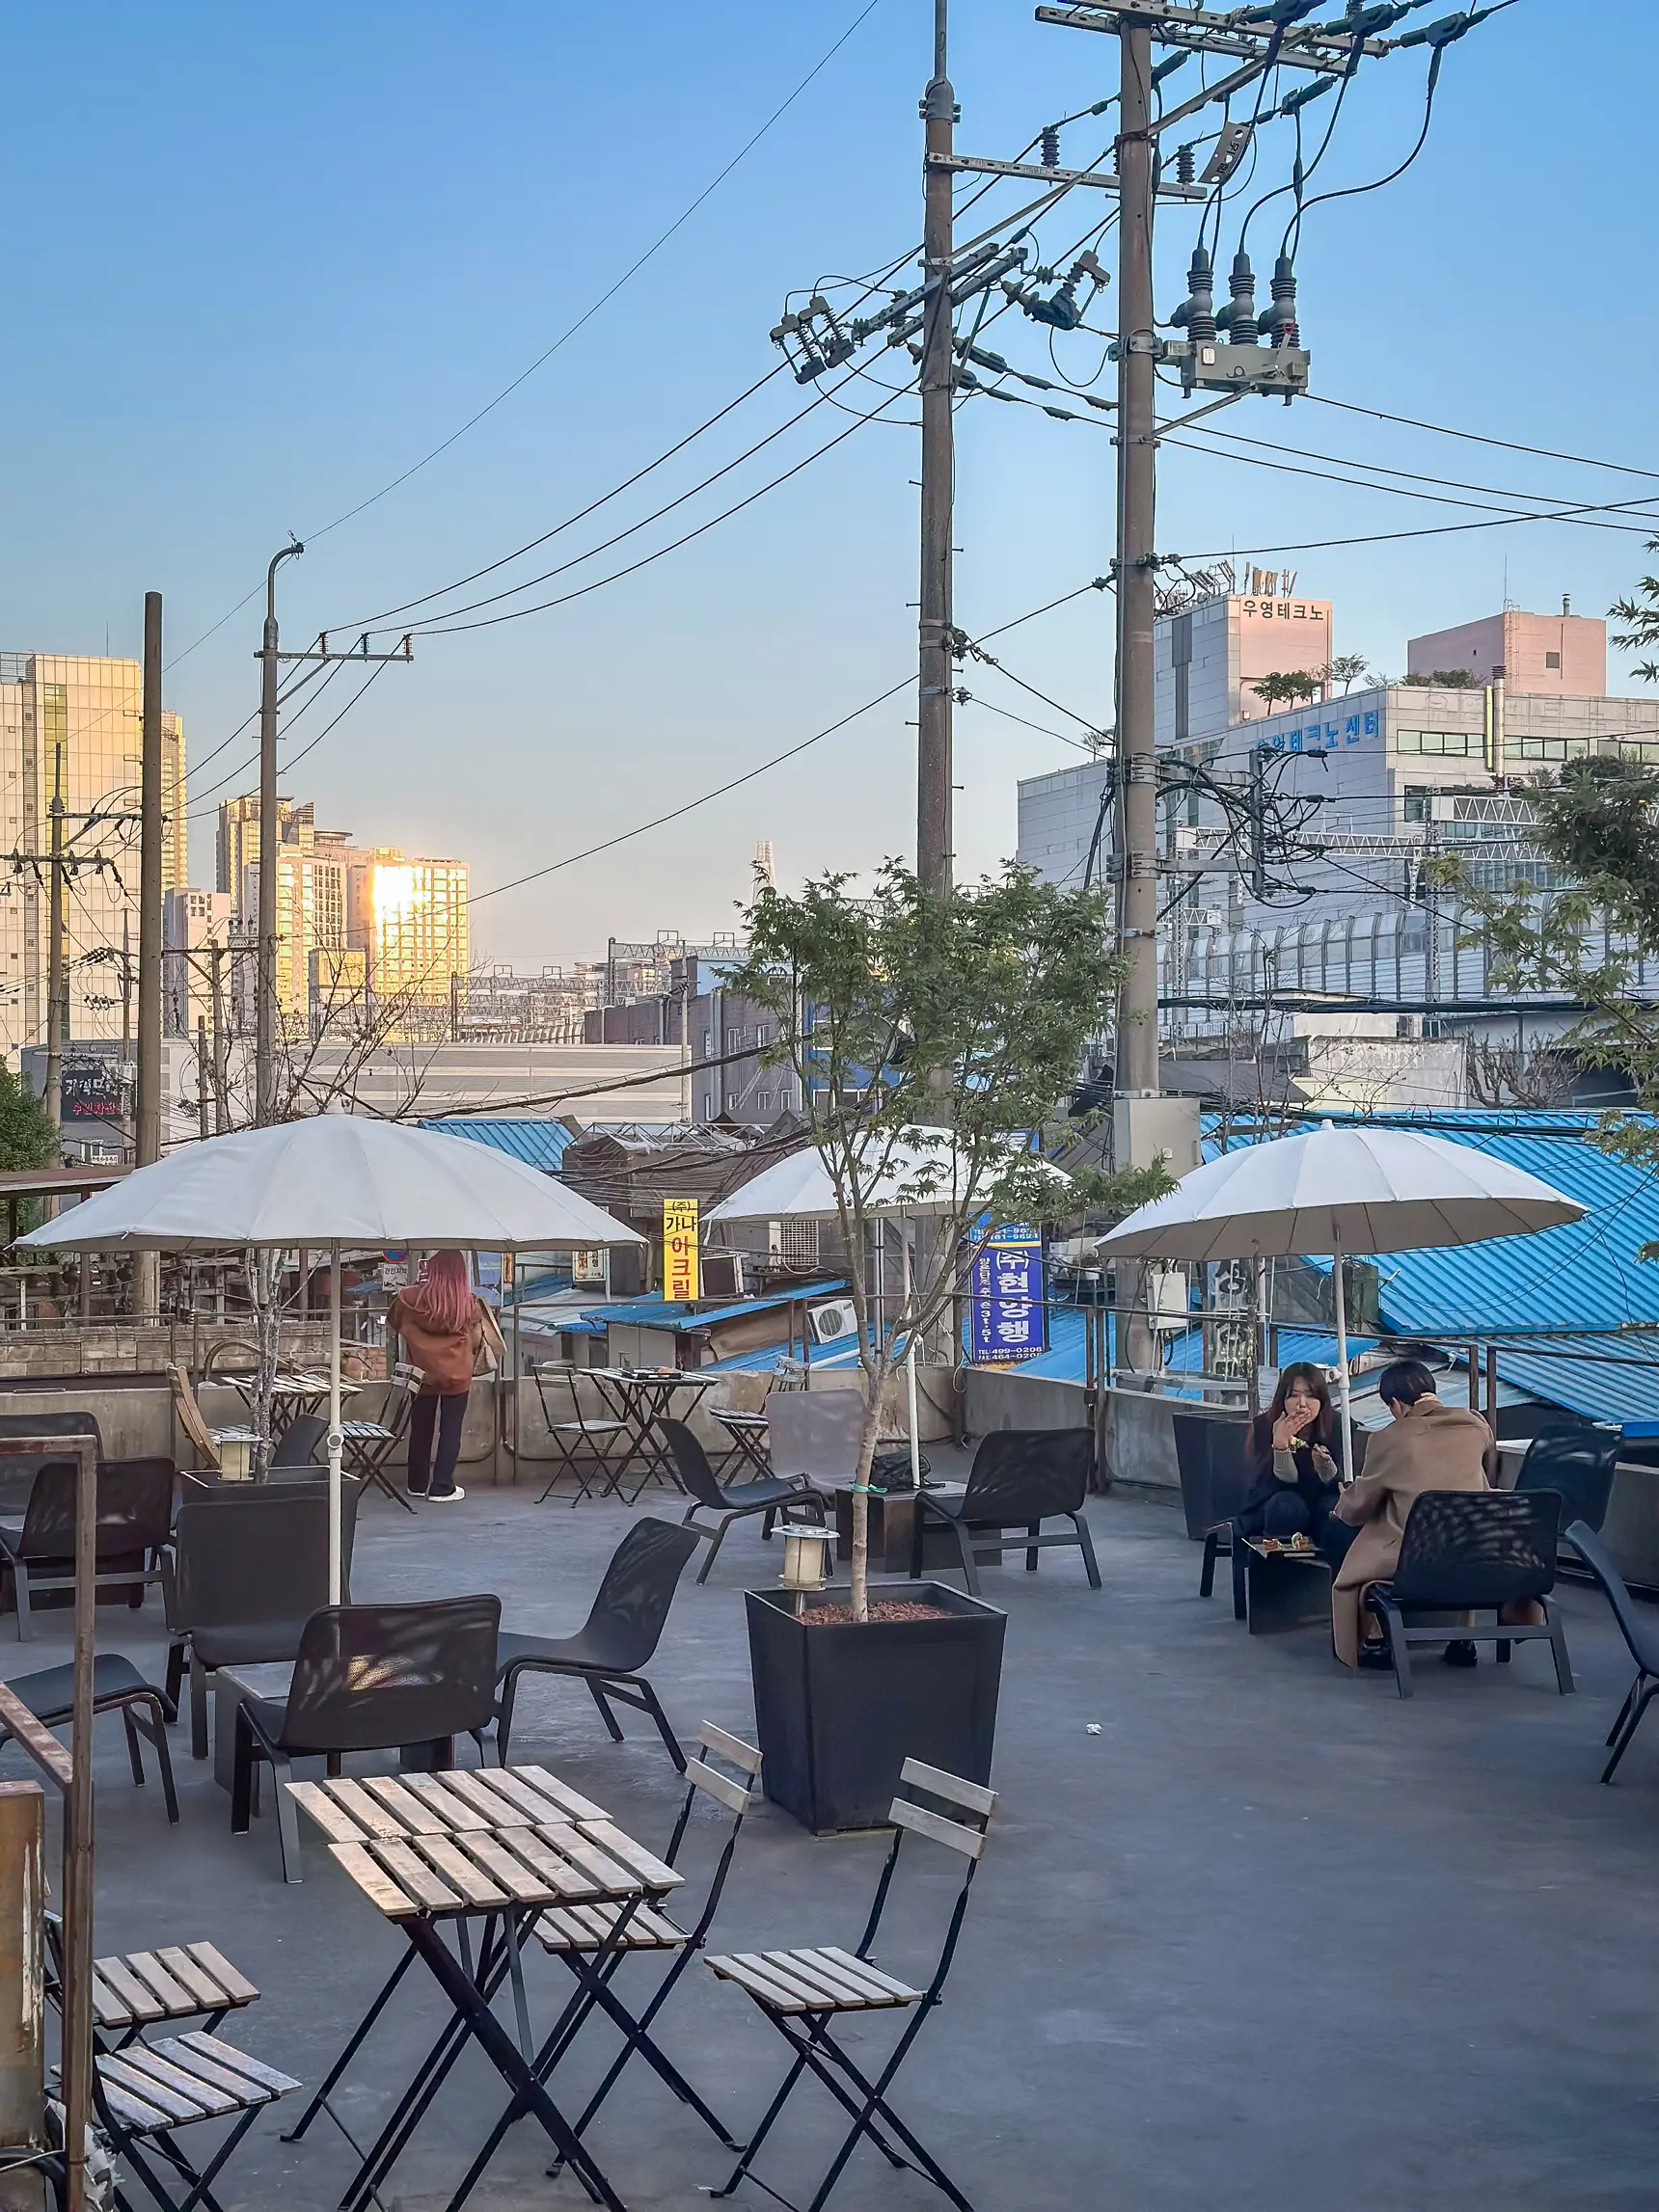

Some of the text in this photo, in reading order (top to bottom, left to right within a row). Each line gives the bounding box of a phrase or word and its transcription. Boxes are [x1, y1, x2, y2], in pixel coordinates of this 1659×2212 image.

[1242, 600, 1324, 620] 우영테크노
[1346, 710, 1379, 744] 센터
[672, 1200, 691, 1213] (주)
[666, 1216, 696, 1232] 가나
[671, 1236, 692, 1299] 아크릴
